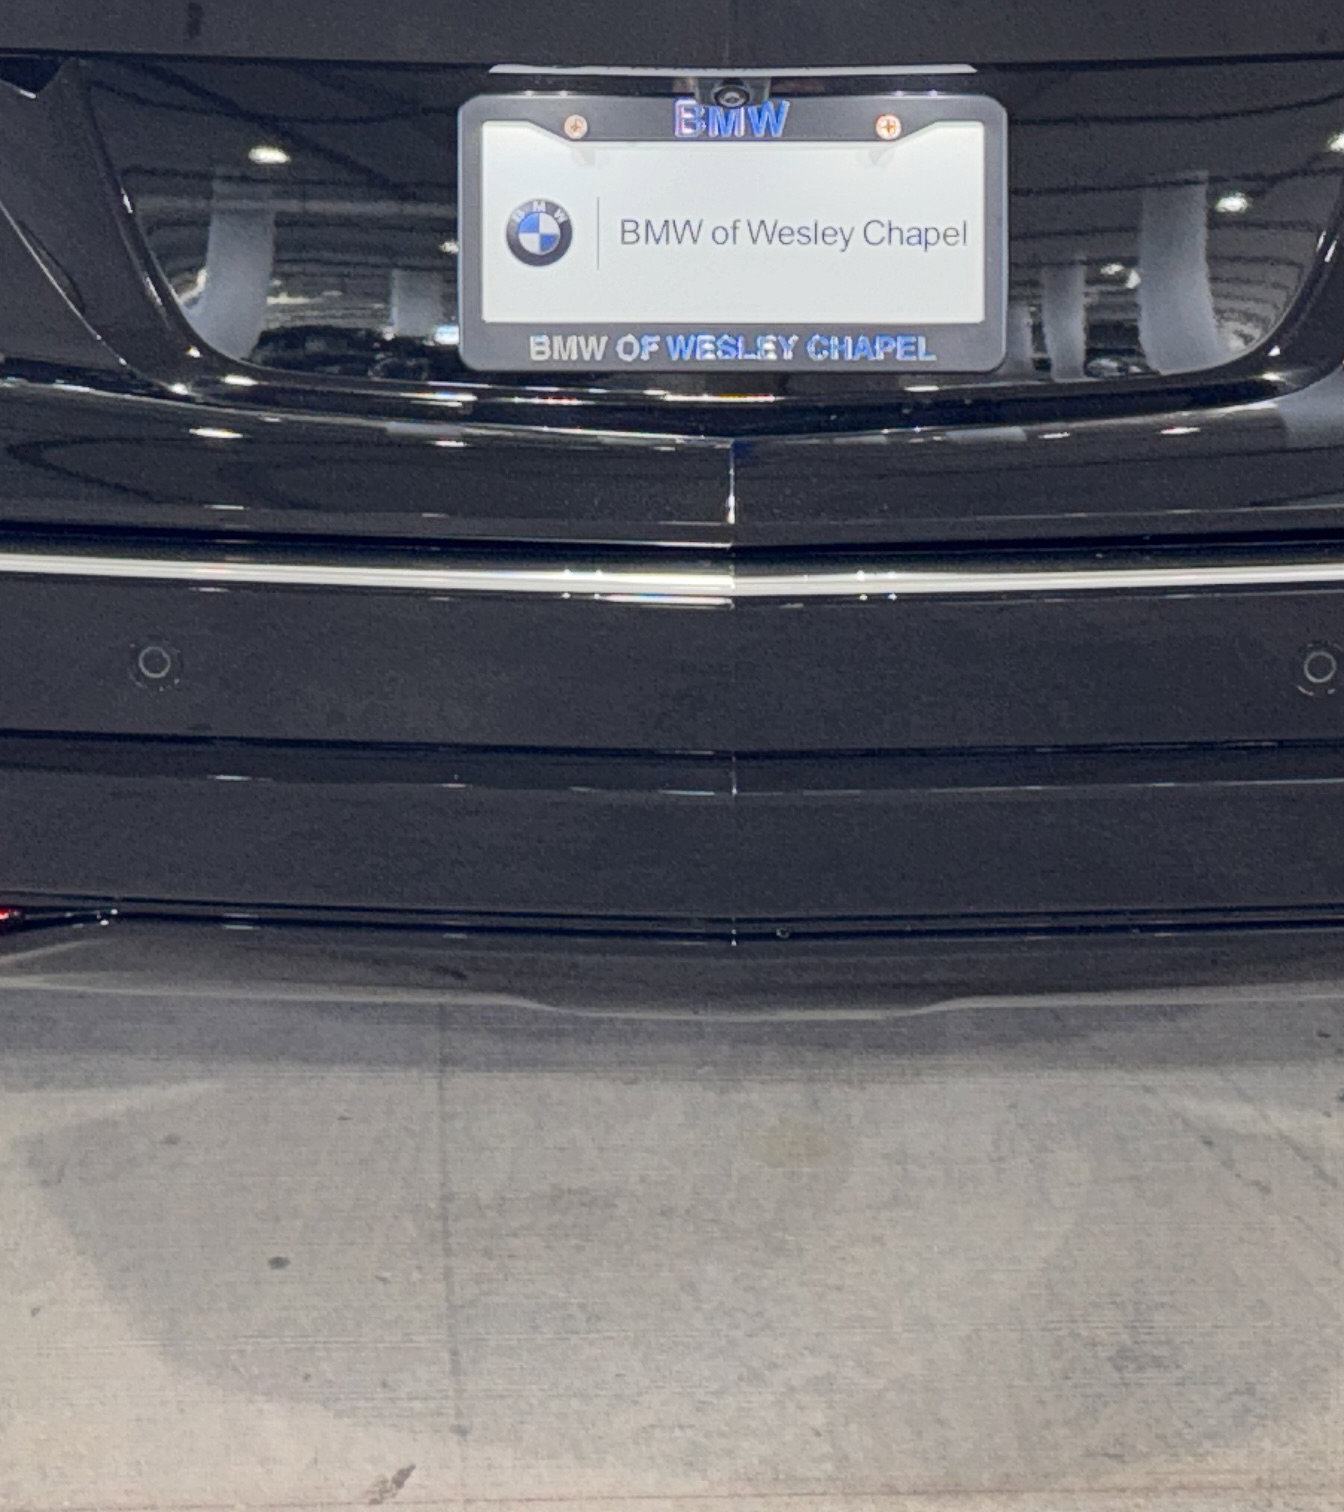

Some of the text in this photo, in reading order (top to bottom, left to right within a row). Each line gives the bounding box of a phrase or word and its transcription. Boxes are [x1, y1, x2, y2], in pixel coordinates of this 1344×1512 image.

[674, 99, 790, 137] BMW
[511, 199, 569, 224] BMW
[620, 218, 967, 252] BMW of Wesley Chapel
[529, 334, 937, 361] BMW OF WESLEY CHAPEL
